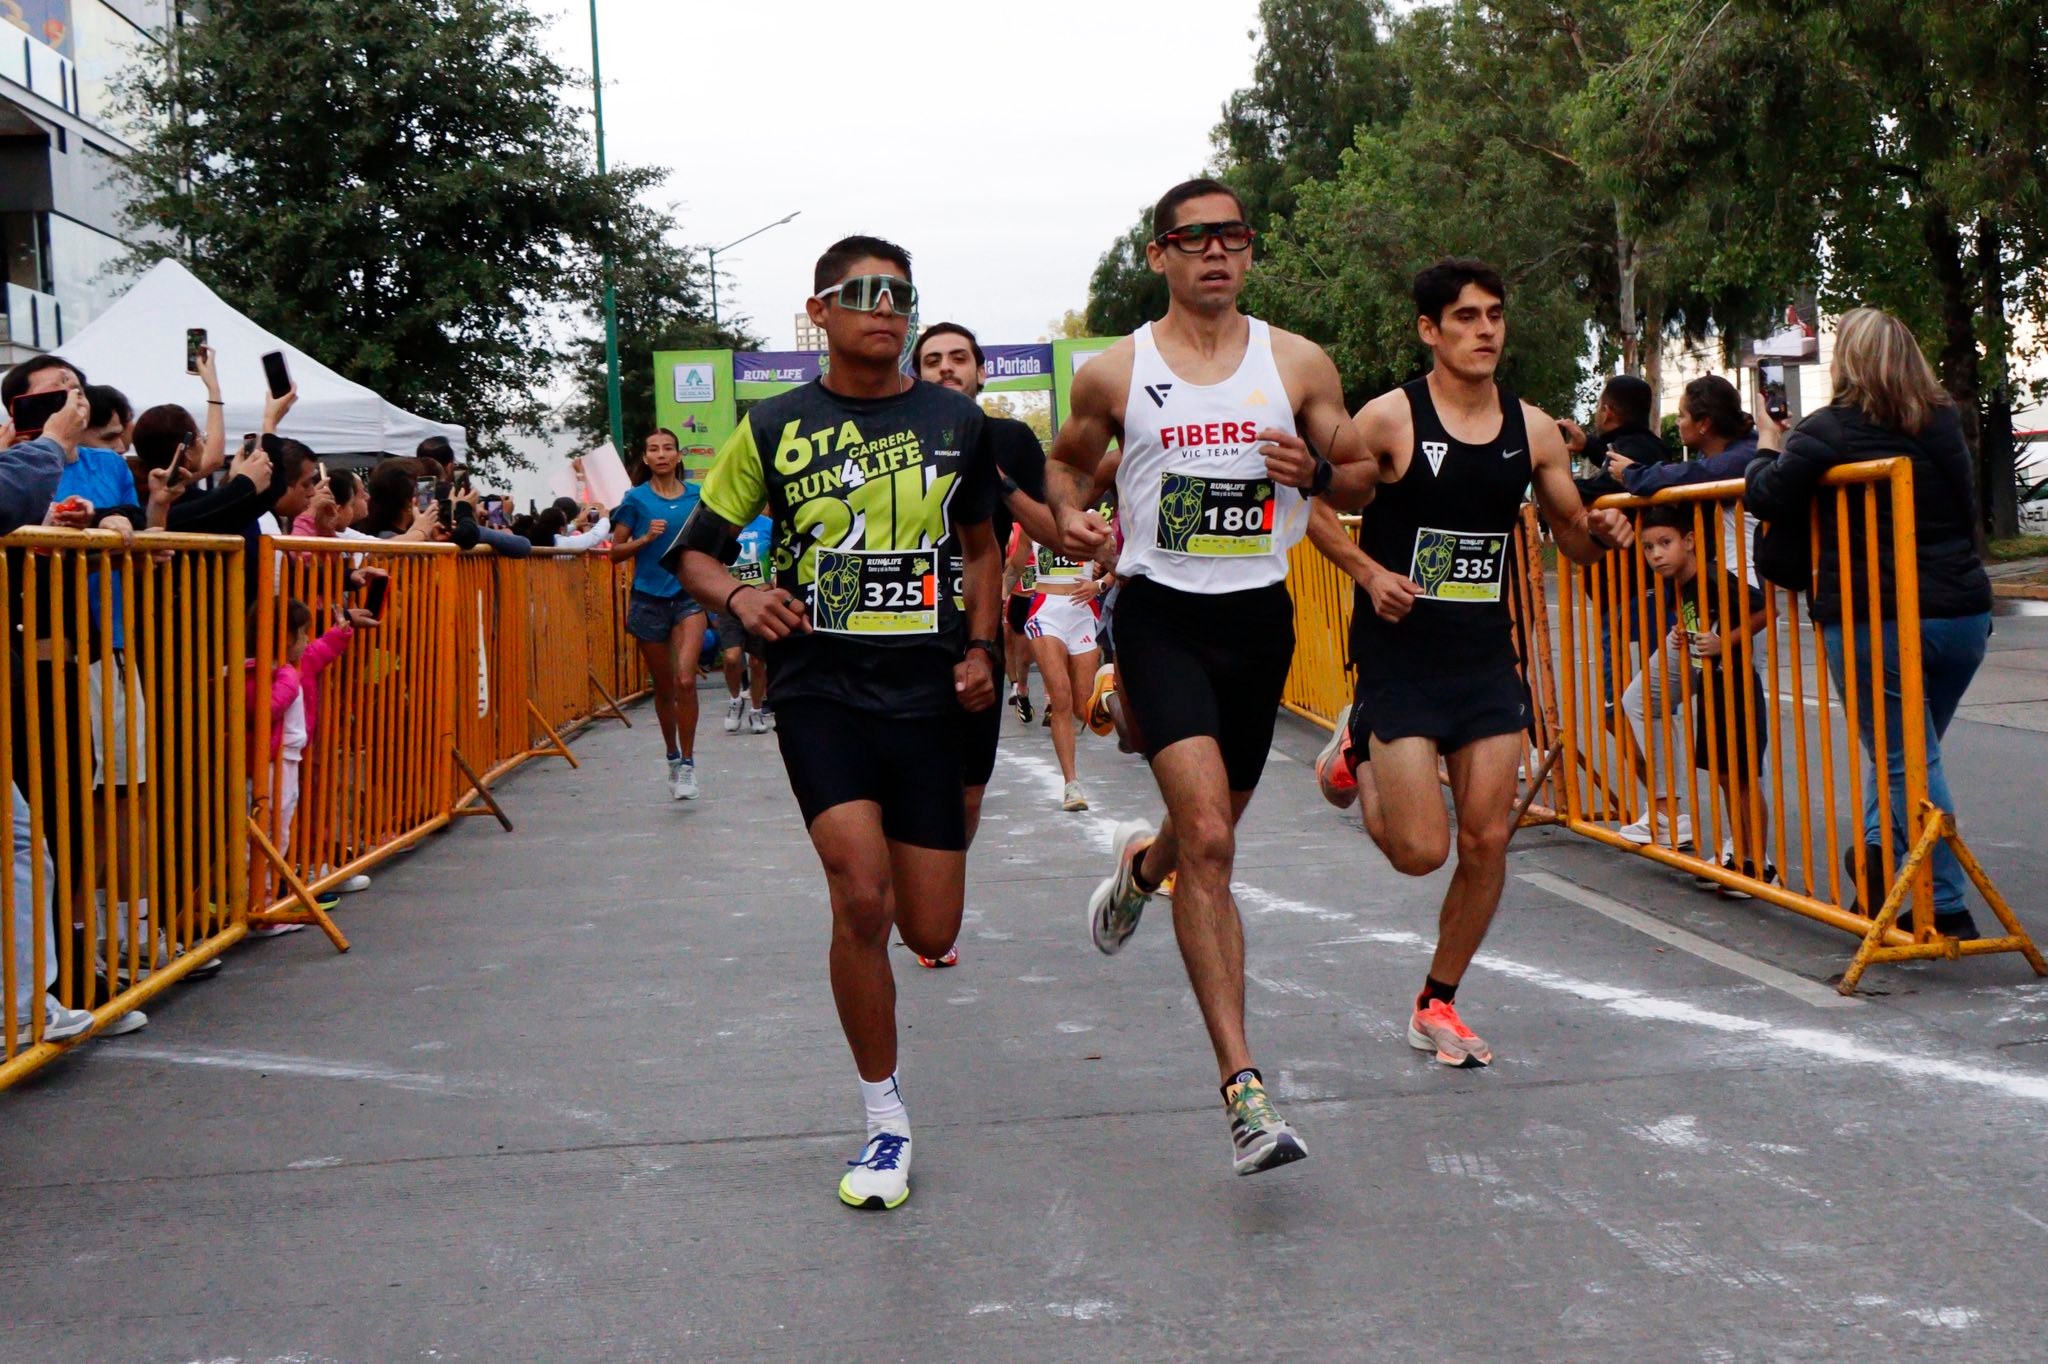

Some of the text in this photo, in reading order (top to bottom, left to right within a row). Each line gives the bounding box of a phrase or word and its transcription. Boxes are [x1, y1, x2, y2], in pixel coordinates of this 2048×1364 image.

[984, 356, 1040, 375] la Portada
[774, 418, 865, 476] 6TA
[849, 429, 916, 459] CARRERA
[1160, 421, 1258, 450] FIBERS
[1182, 448, 1239, 458] VIC TEAM
[784, 441, 923, 507] RUN4LIFE
[1204, 507, 1263, 531] 180
[740, 570, 758, 580] 222
[1453, 558, 1494, 579] 335
[864, 581, 923, 607] 325
